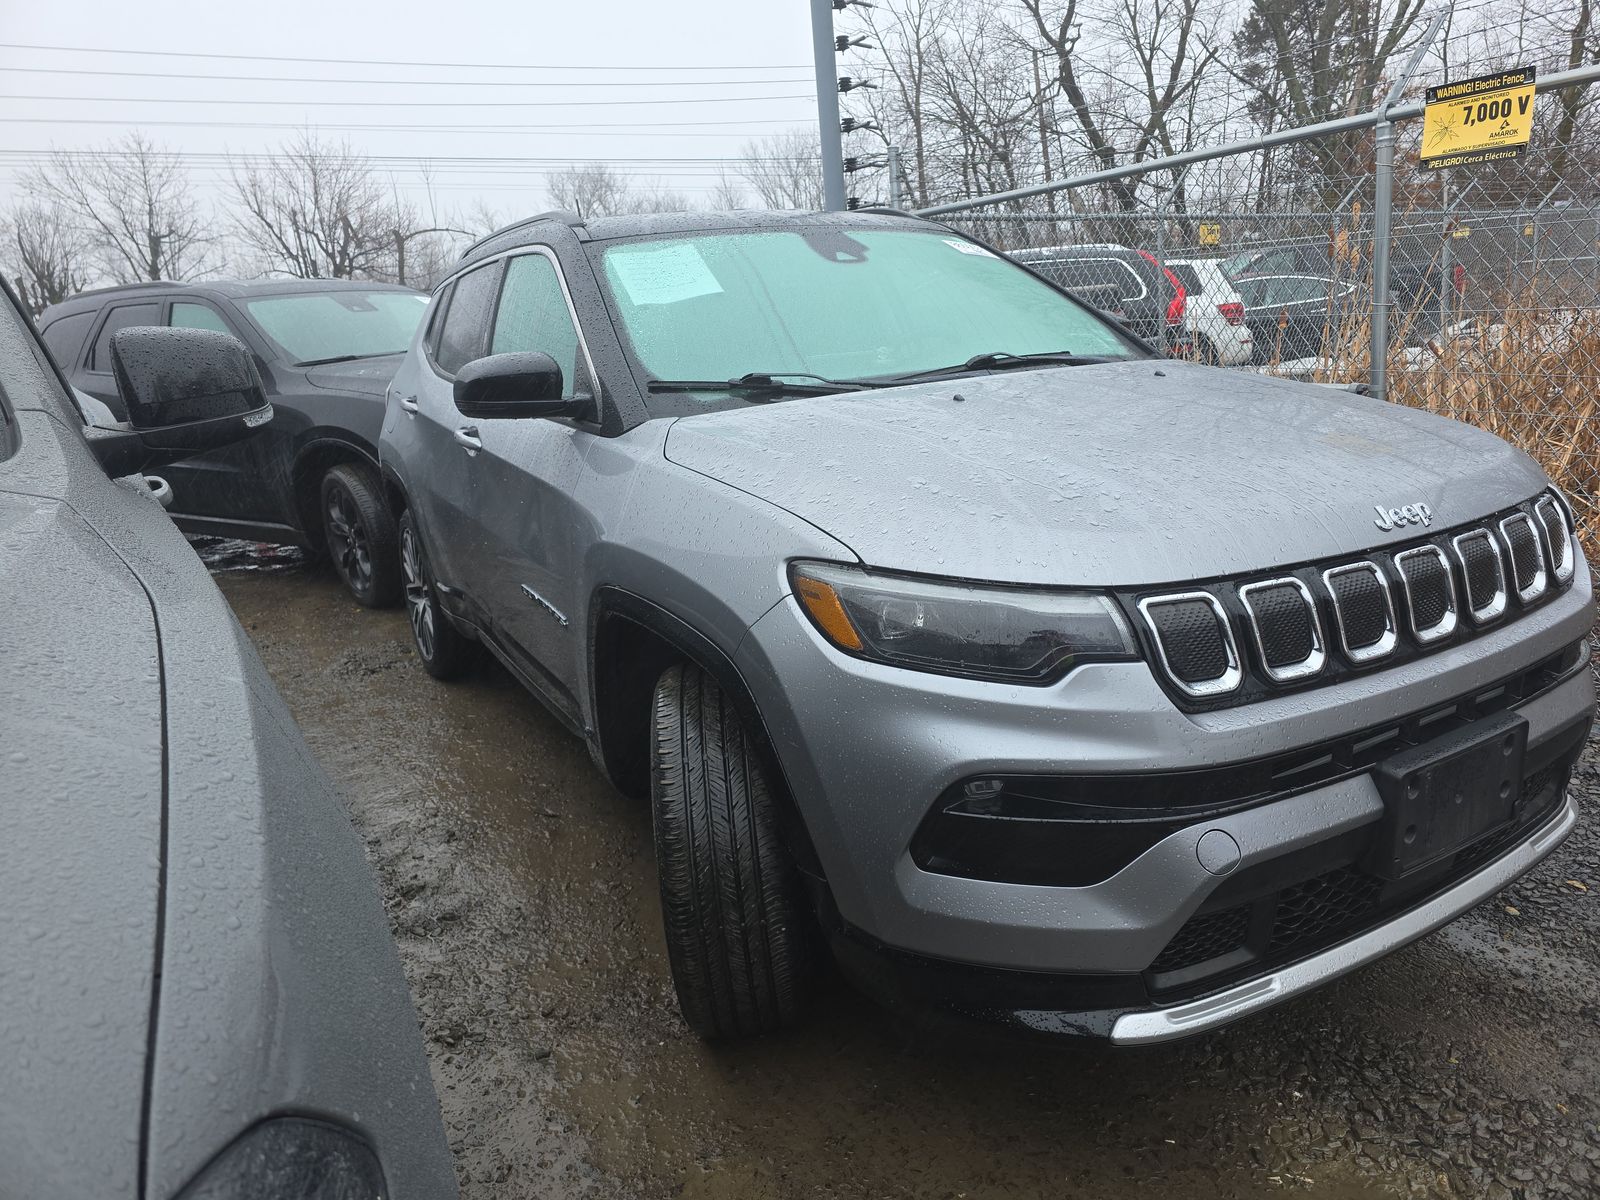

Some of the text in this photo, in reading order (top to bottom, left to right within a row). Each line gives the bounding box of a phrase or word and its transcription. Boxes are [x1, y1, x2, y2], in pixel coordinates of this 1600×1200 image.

[1436, 73, 1525, 99] WARNING! Electric Fence
[1448, 99, 1470, 108] ALARMED
[1481, 91, 1510, 101] MONITORED
[1463, 94, 1531, 127] 7,000 V
[1489, 128, 1519, 139] AMAROK
[1463, 155, 1483, 164] Cerca
[1484, 150, 1517, 161] Eléctrica
[1373, 502, 1433, 533] Jeep
